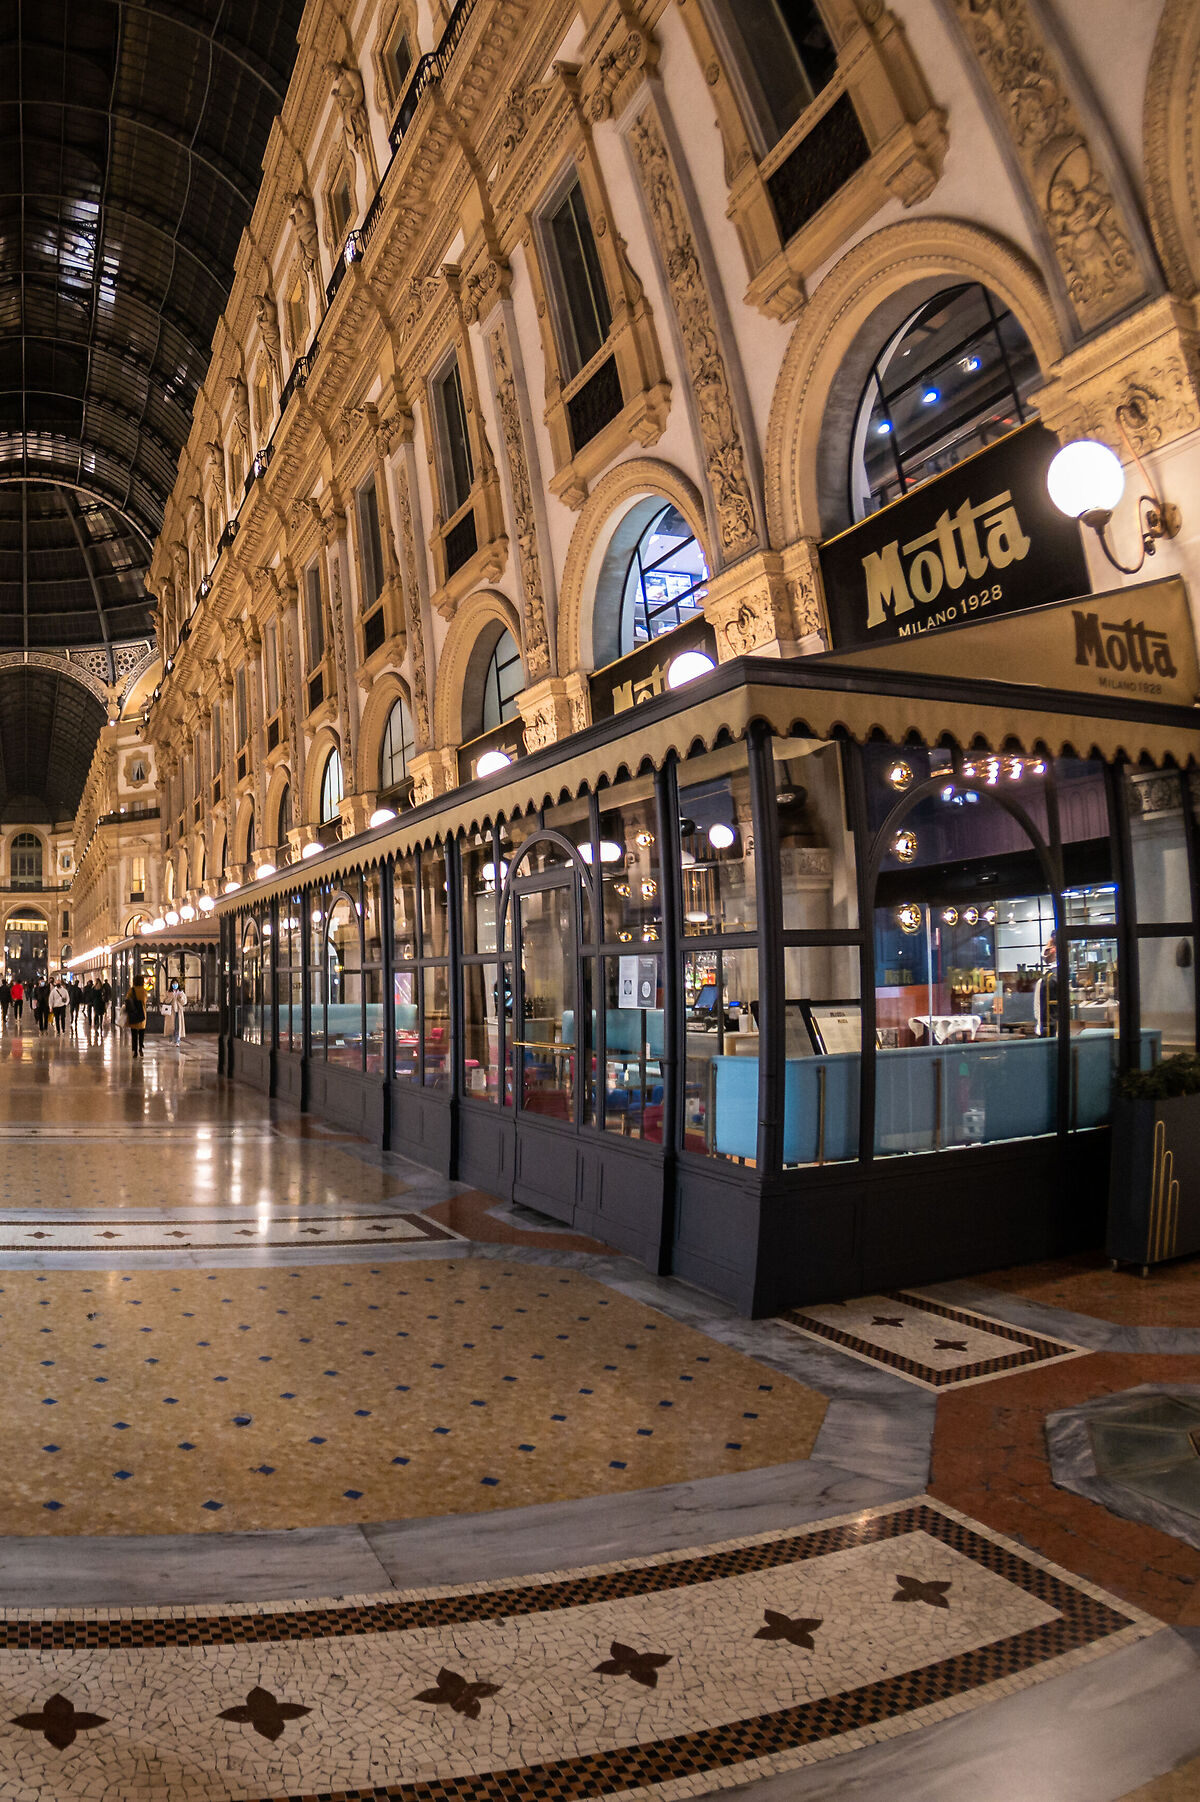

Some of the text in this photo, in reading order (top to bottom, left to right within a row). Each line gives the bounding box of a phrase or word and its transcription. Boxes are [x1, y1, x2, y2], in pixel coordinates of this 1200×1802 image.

[861, 489, 1031, 628] Motta
[898, 584, 1003, 637] MILANO 1928
[1071, 610, 1178, 679] Motta
[1098, 677, 1162, 695] MILANO 1928
